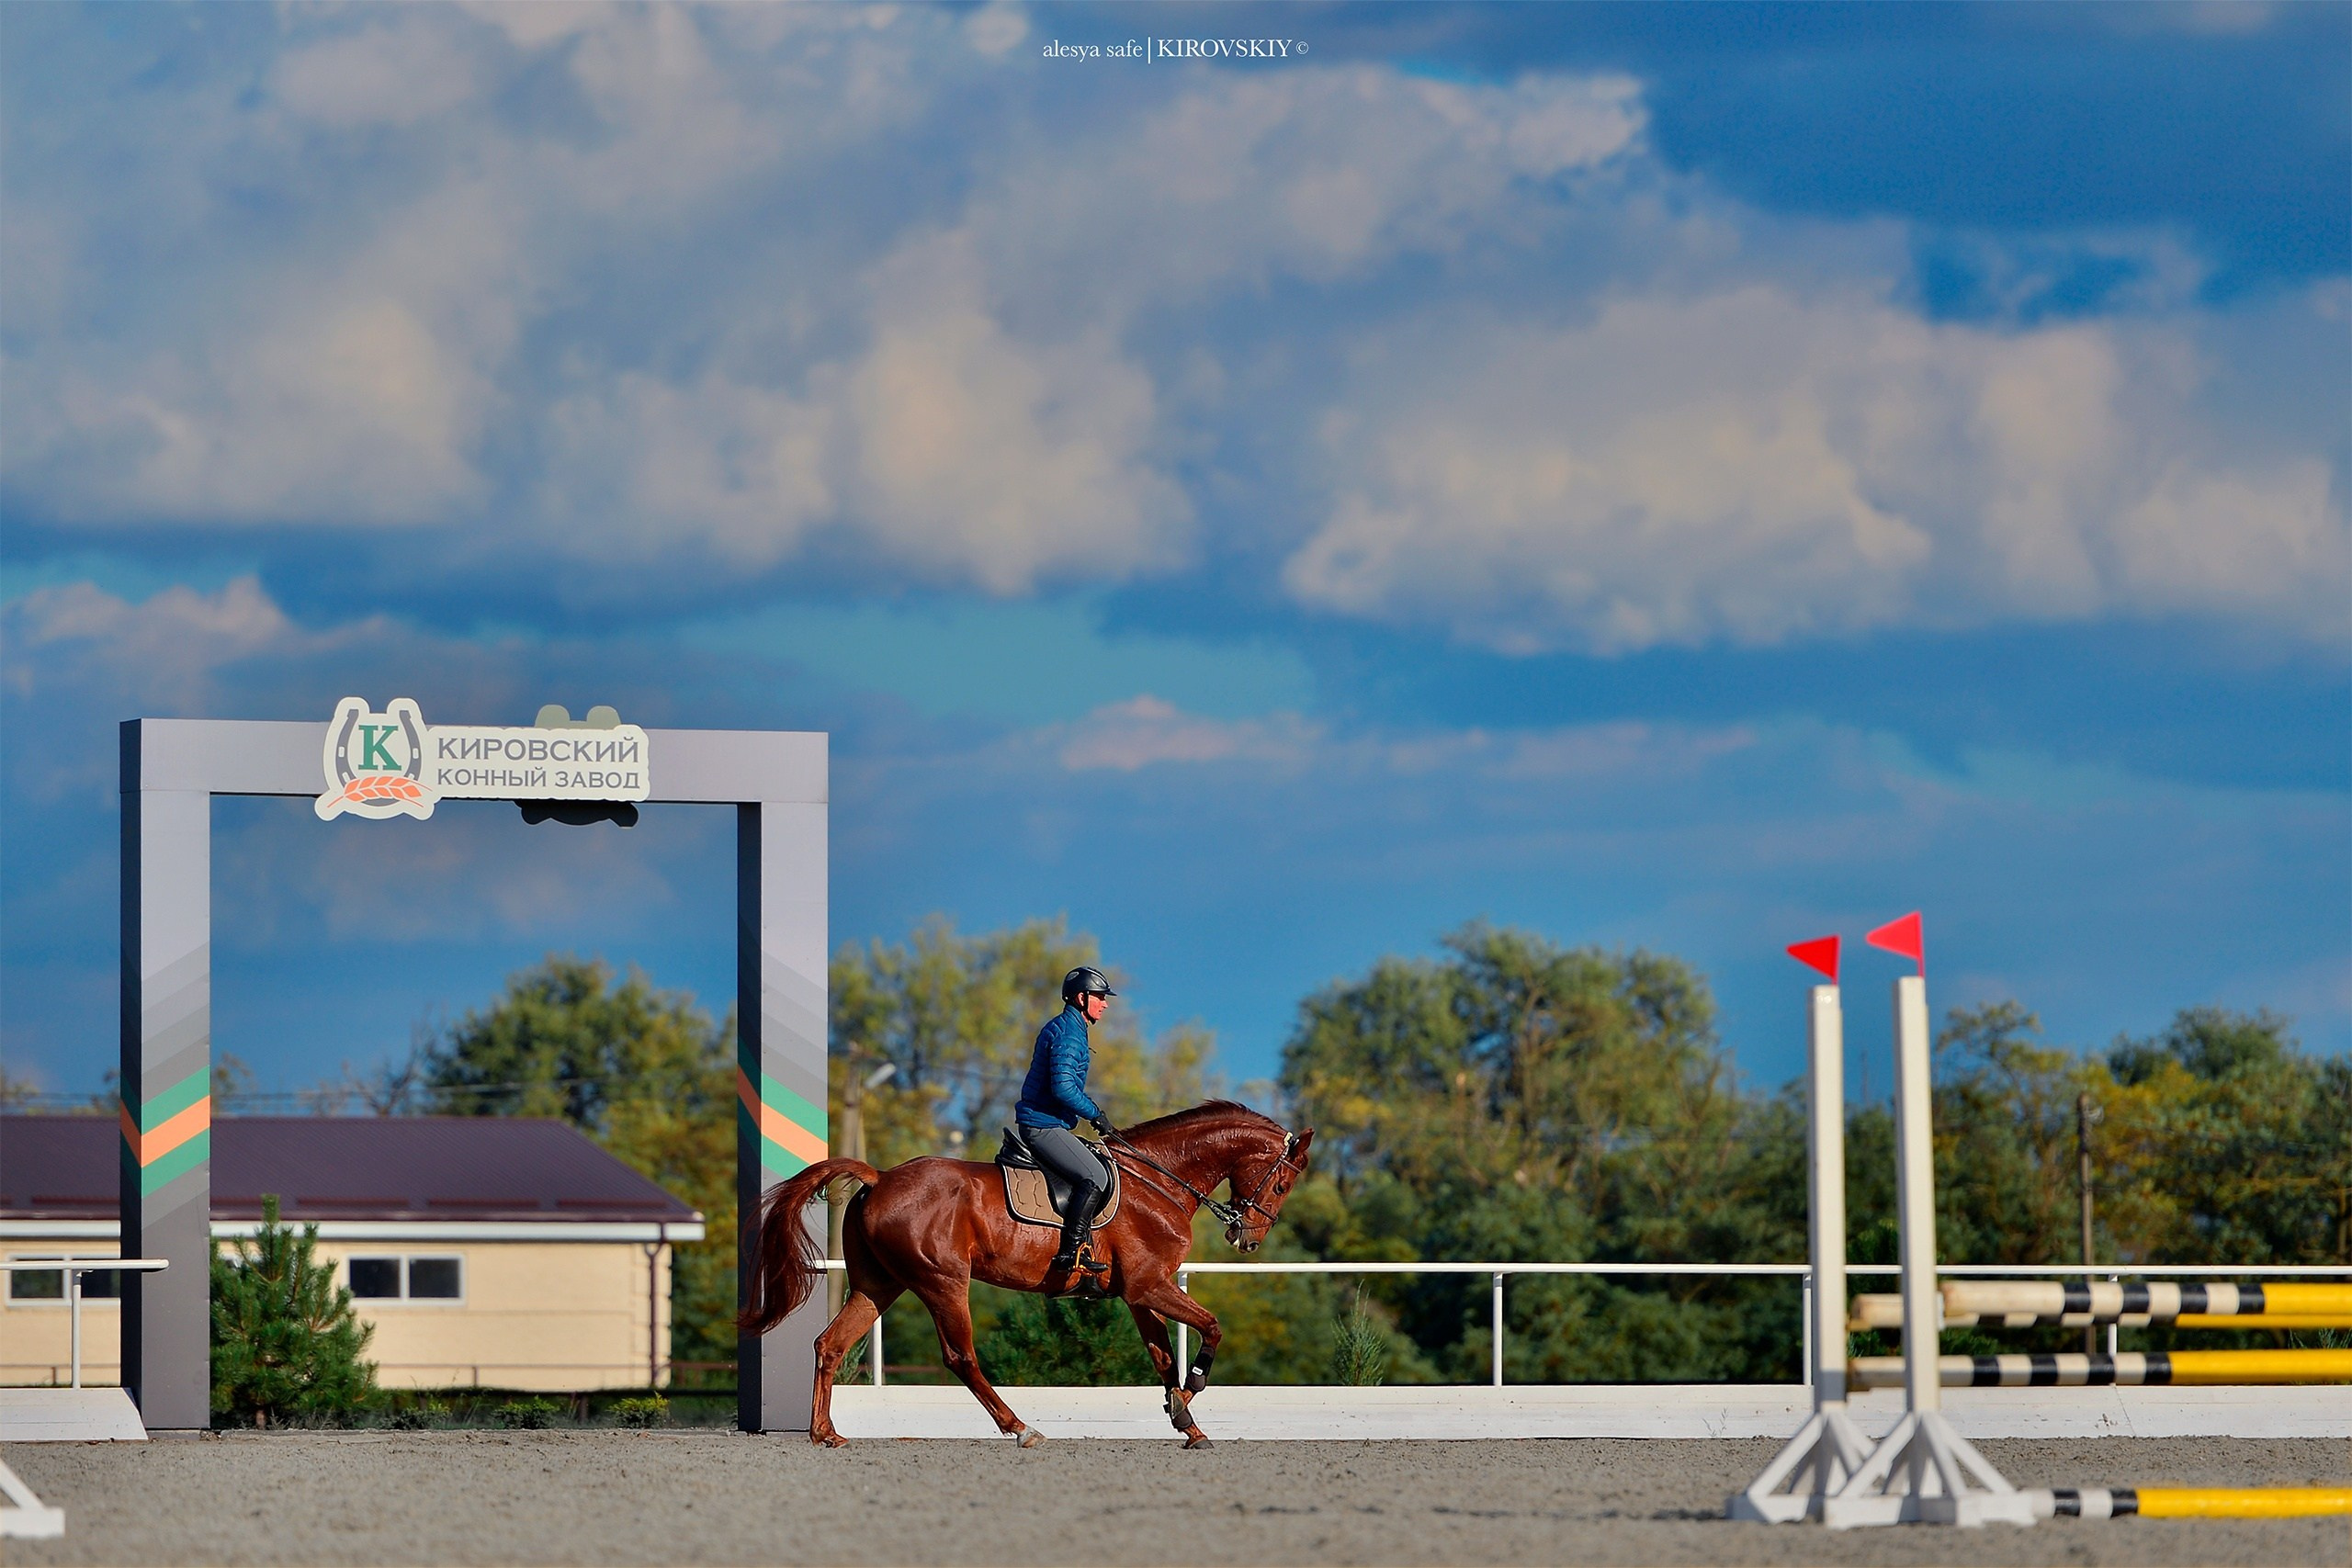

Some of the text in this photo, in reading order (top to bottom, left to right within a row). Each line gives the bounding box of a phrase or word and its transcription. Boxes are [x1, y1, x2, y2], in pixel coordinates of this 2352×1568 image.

[438, 736, 639, 763] КИРОВСКИЙ
[436, 767, 640, 789] КОННЫЙ ЗАВОД
